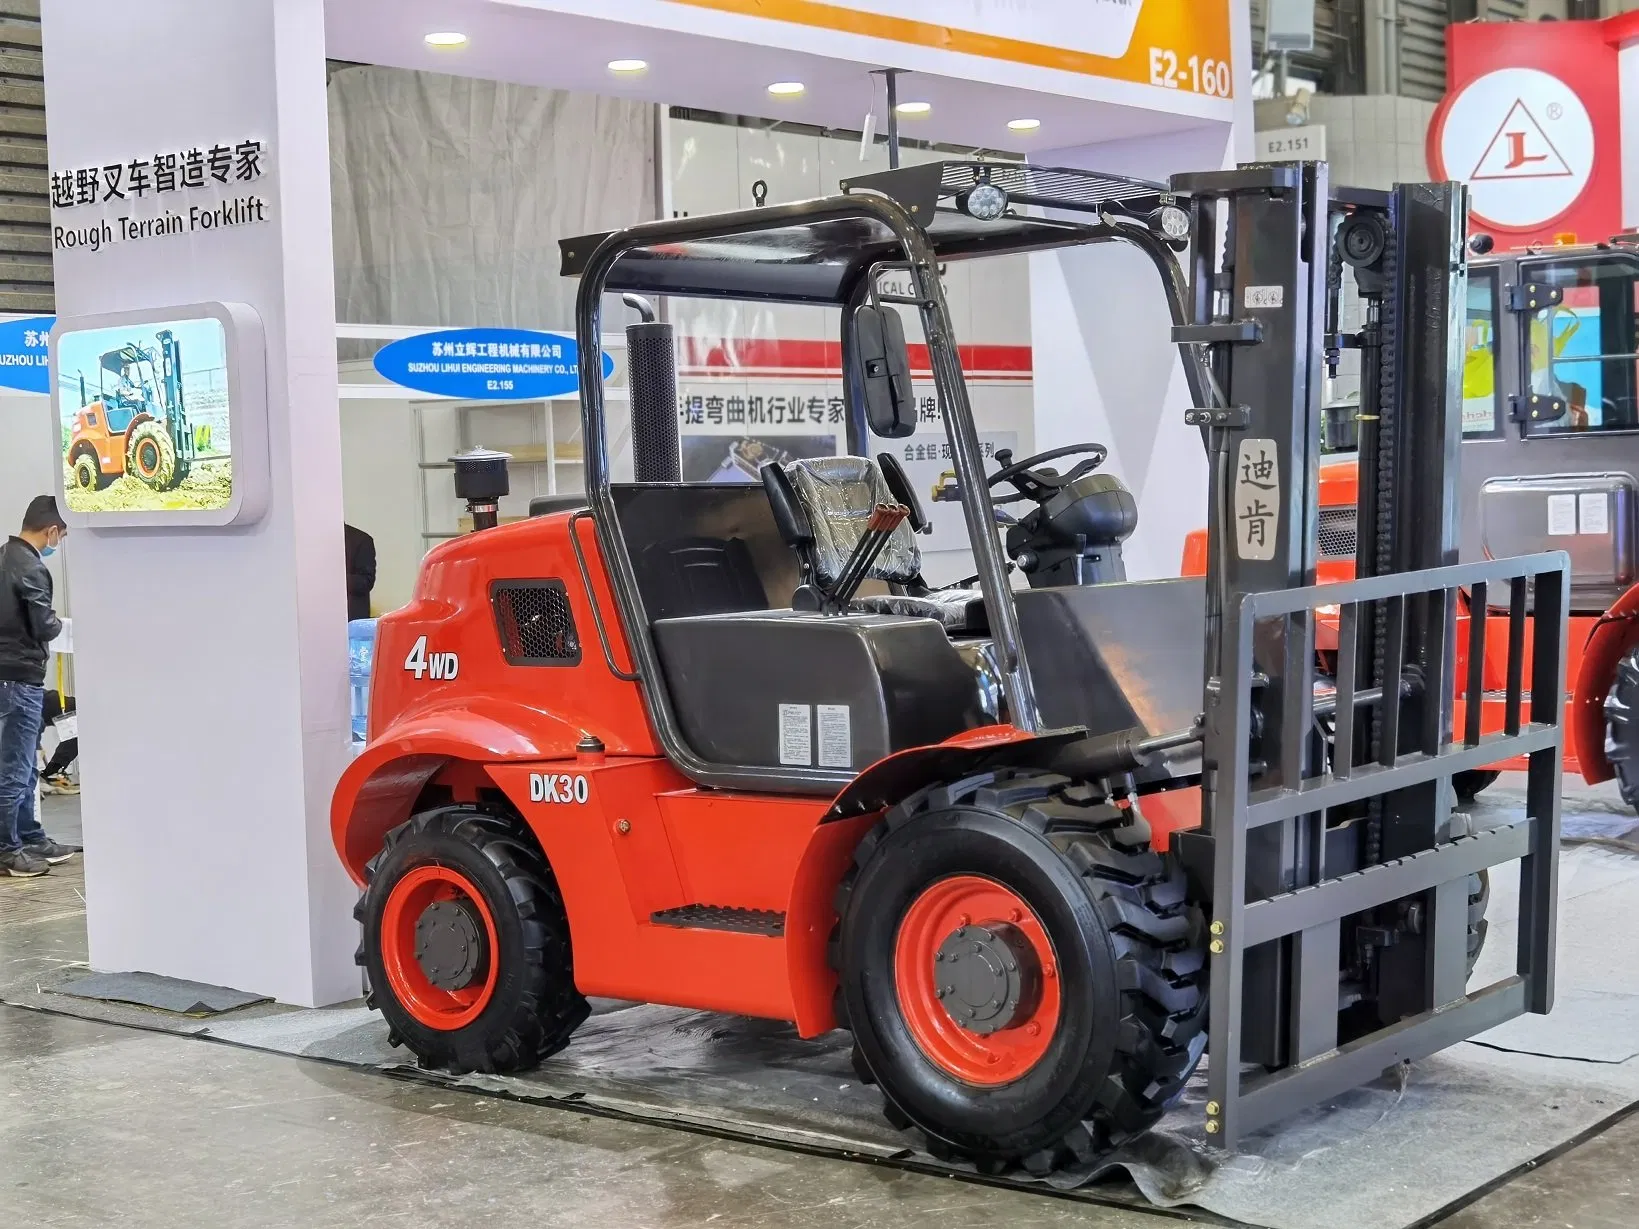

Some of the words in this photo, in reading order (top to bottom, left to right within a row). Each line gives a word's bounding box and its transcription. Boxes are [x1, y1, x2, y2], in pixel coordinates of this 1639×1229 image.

[1149, 47, 1230, 97] E2-160
[1268, 137, 1309, 153] E2.151
[51, 140, 262, 209] 越野叉车智造专家
[54, 218, 112, 251] Rough
[118, 209, 183, 241] Terrain
[189, 195, 264, 231] Forklift
[431, 341, 562, 359] 苏州立辉工程机械有限公司
[407, 362, 440, 373] SUZHOU
[440, 362, 461, 373] LIHUI
[461, 363, 511, 374] ENGINEERING
[512, 364, 554, 374] MACHINERY
[554, 365, 569, 376] CO.,
[486, 380, 514, 391] E2.155
[680, 395, 844, 425] 提弯曲机行业专家
[1239, 450, 1278, 548] 迪肯
[404, 635, 459, 680] 4WD
[529, 773, 589, 804] DK30
